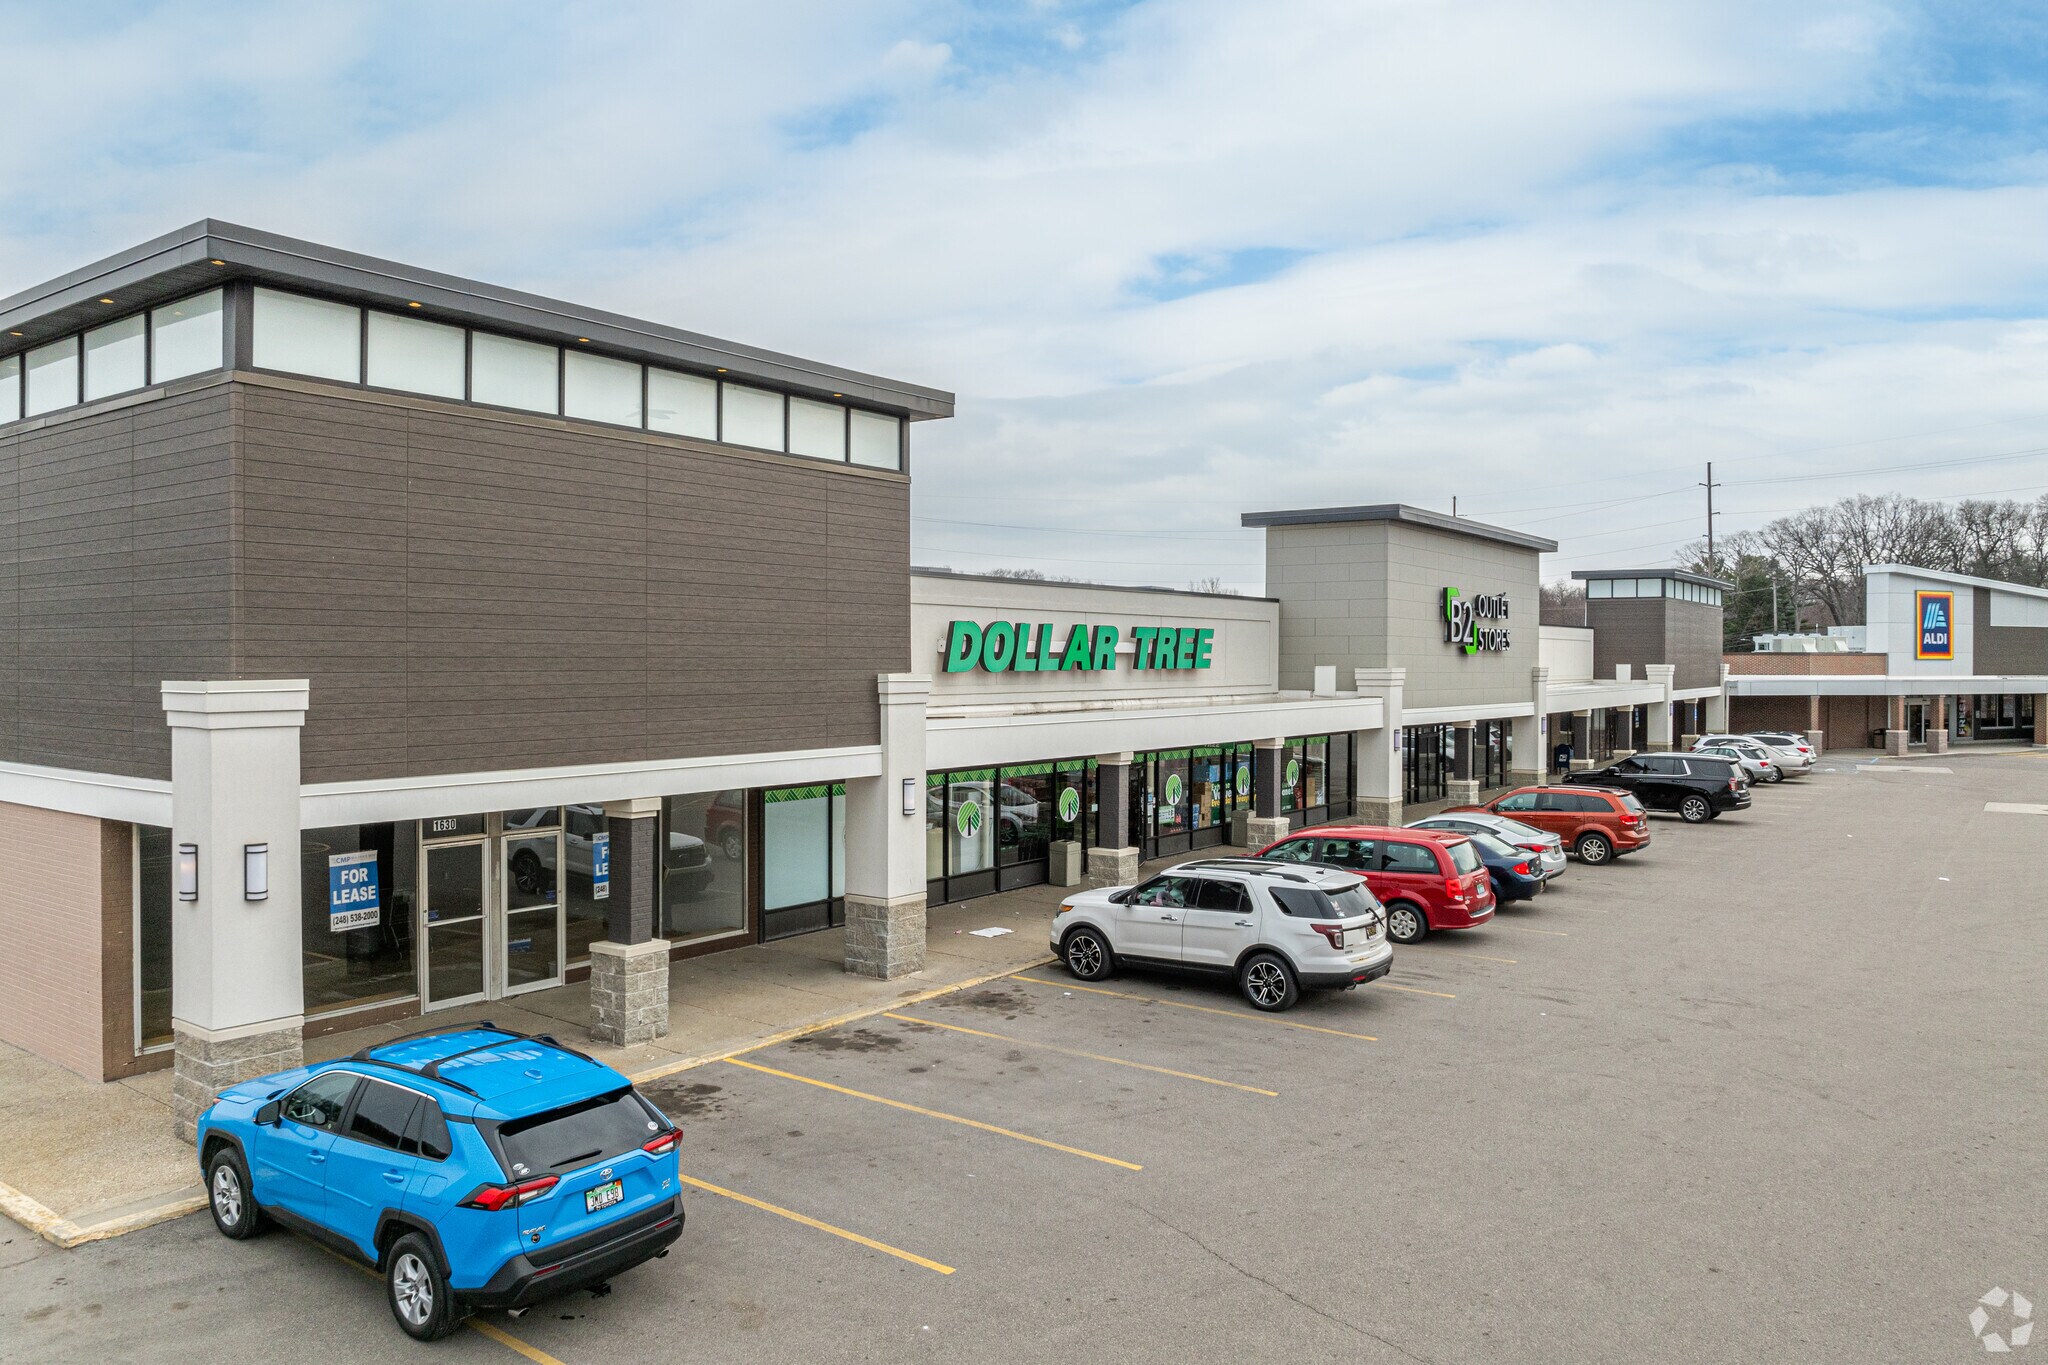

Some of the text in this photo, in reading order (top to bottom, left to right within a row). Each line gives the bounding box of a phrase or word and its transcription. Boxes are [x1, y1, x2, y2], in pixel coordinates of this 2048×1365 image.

[1476, 594, 1511, 619] OUTLET
[1447, 599, 1473, 643] B2
[942, 620, 1215, 673] DOLLAR TREE
[1478, 628, 1511, 651] STORES
[1923, 632, 1948, 645] ALDI
[434, 819, 456, 831] 1630
[336, 856, 351, 864] CMP
[341, 867, 369, 885] FOR
[333, 885, 377, 906] LEASE
[333, 914, 349, 927] (248)
[350, 910, 379, 923] 538-2000
